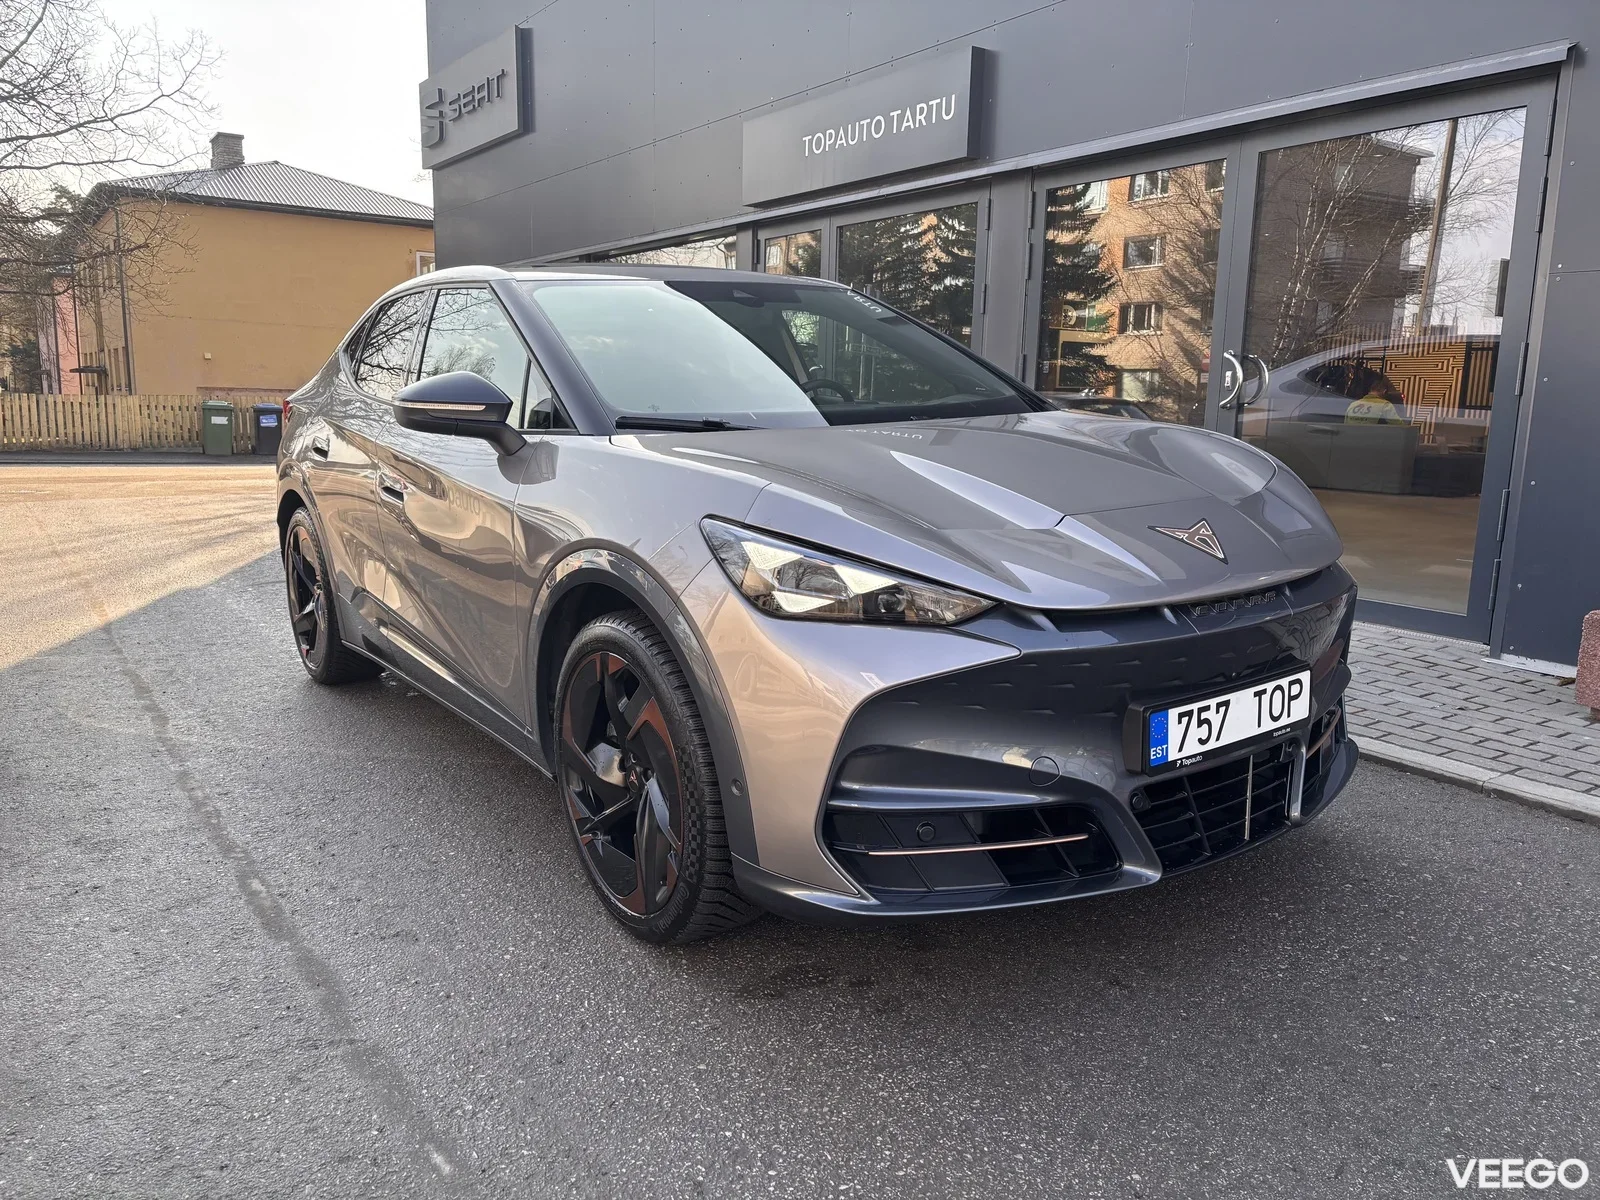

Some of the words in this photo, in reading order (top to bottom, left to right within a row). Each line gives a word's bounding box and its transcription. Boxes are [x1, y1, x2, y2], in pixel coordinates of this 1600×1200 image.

[448, 68, 506, 122] SEAT
[802, 115, 886, 157] TOPAUTO
[889, 94, 956, 134] TARTU
[1177, 699, 1231, 754] 757
[1253, 677, 1304, 729] TOP
[1150, 744, 1168, 760] EST
[1182, 755, 1203, 766] Topauto
[656, 881, 690, 934] Continental
